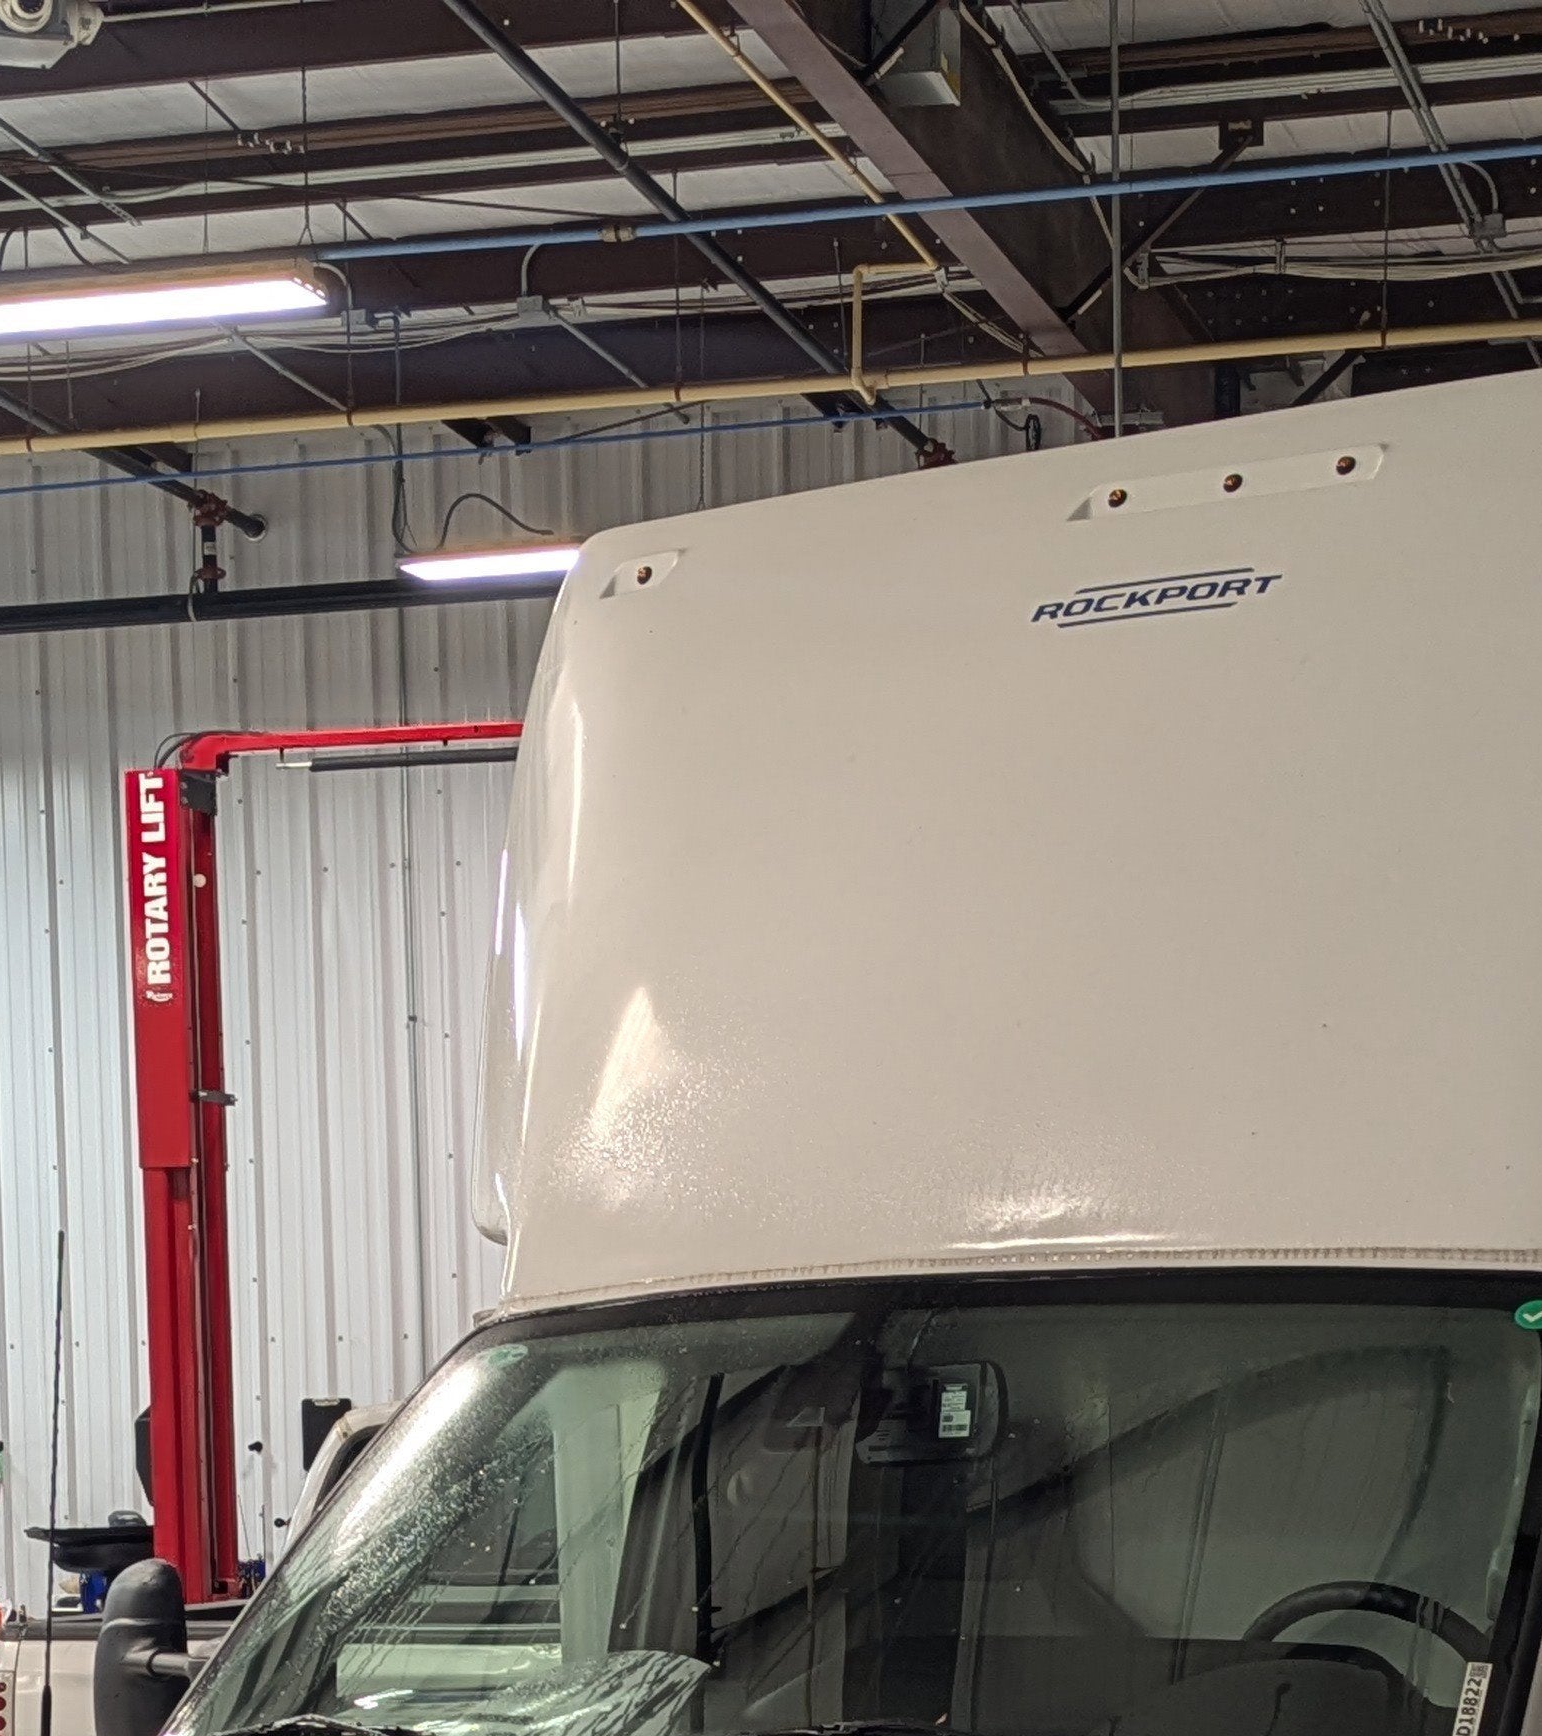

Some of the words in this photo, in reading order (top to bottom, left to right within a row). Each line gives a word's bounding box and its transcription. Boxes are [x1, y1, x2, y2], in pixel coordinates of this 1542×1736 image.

[1030, 574, 1283, 623] ROCKPORT
[138, 773, 166, 843] LIFT
[142, 851, 172, 986] ROTARY
